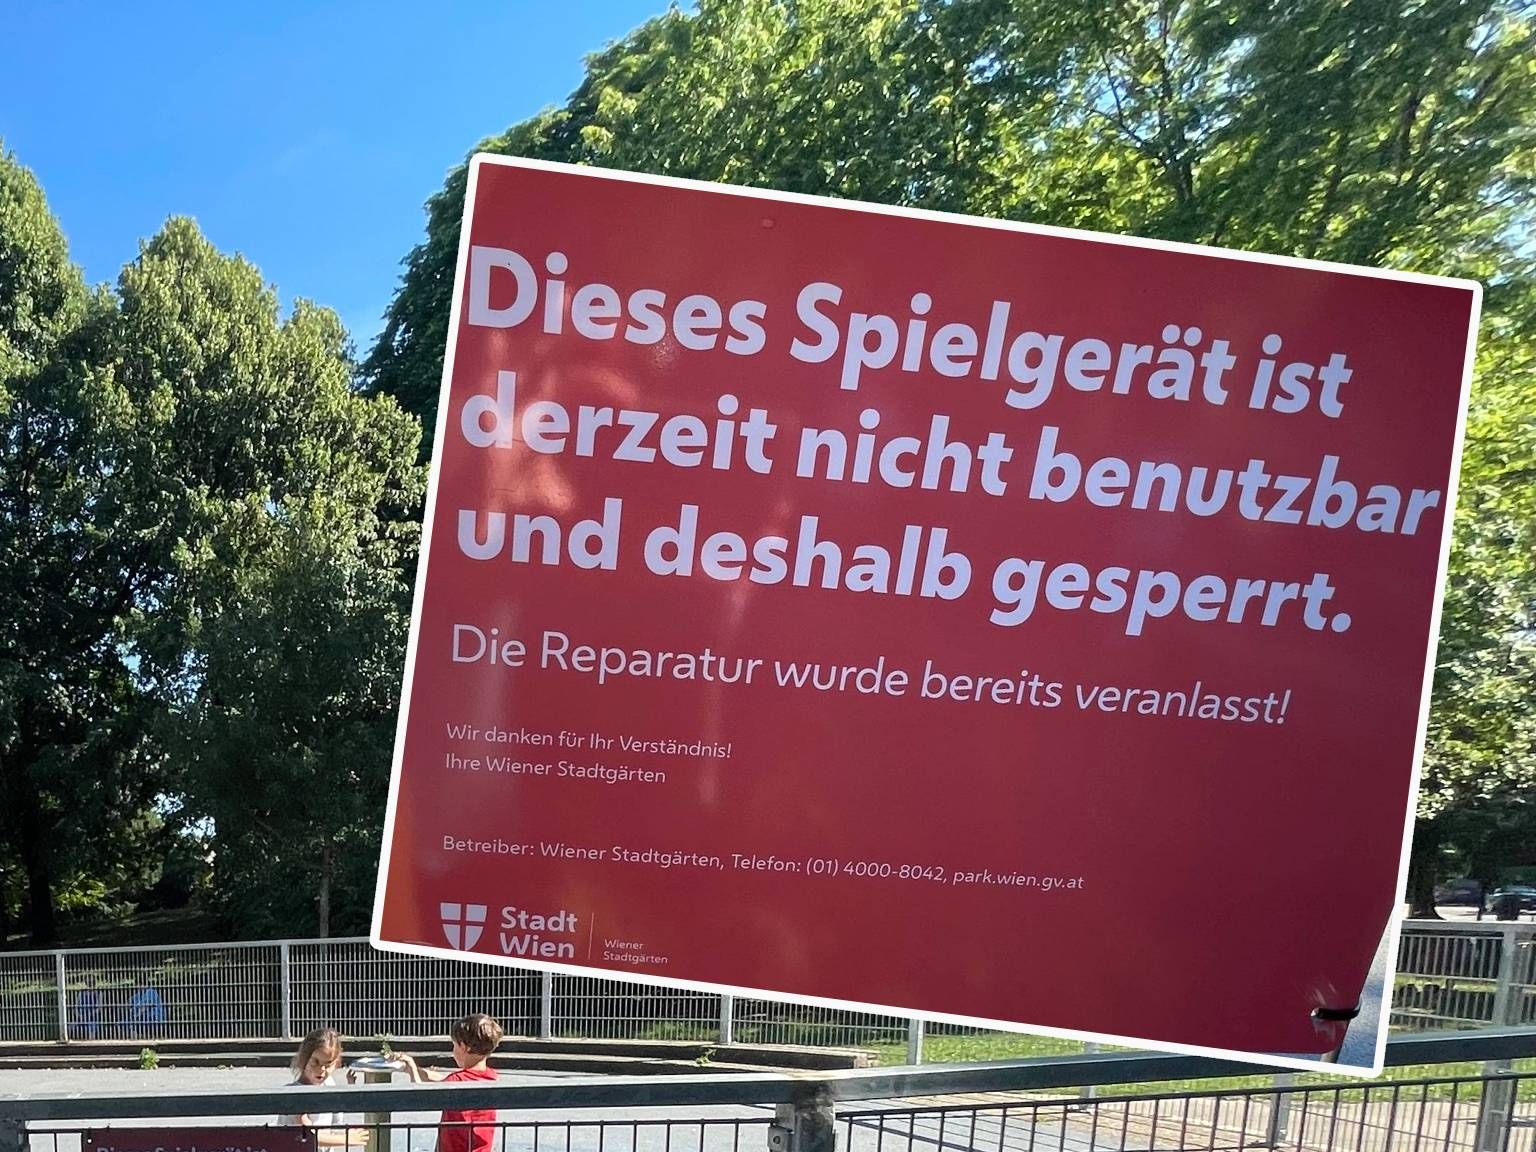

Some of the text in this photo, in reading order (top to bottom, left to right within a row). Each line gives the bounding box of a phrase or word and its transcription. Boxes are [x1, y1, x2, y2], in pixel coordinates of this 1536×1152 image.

[468, 245, 1353, 418] Dieses Spielgerät ist
[460, 369, 1441, 536] derzeit nicht benutzbar
[456, 497, 1352, 637] und deshalb gesperrt.
[451, 623, 1292, 724] Die Reparatur wurde bereits veranlasst!
[446, 723, 732, 758] Wir danken für Ihr Verständnis!
[446, 752, 666, 784] Ihre Wiener Stadtgärten
[443, 835, 1084, 892] Betreiber: Wiener Stadtgärten, Telefon: (01) 4000-8042, park.wien.gv.at
[500, 906, 577, 933] Stadt
[499, 932, 575, 959] Wien
[603, 938, 644, 951] Wiener
[603, 951, 669, 965] Stadtgärten
